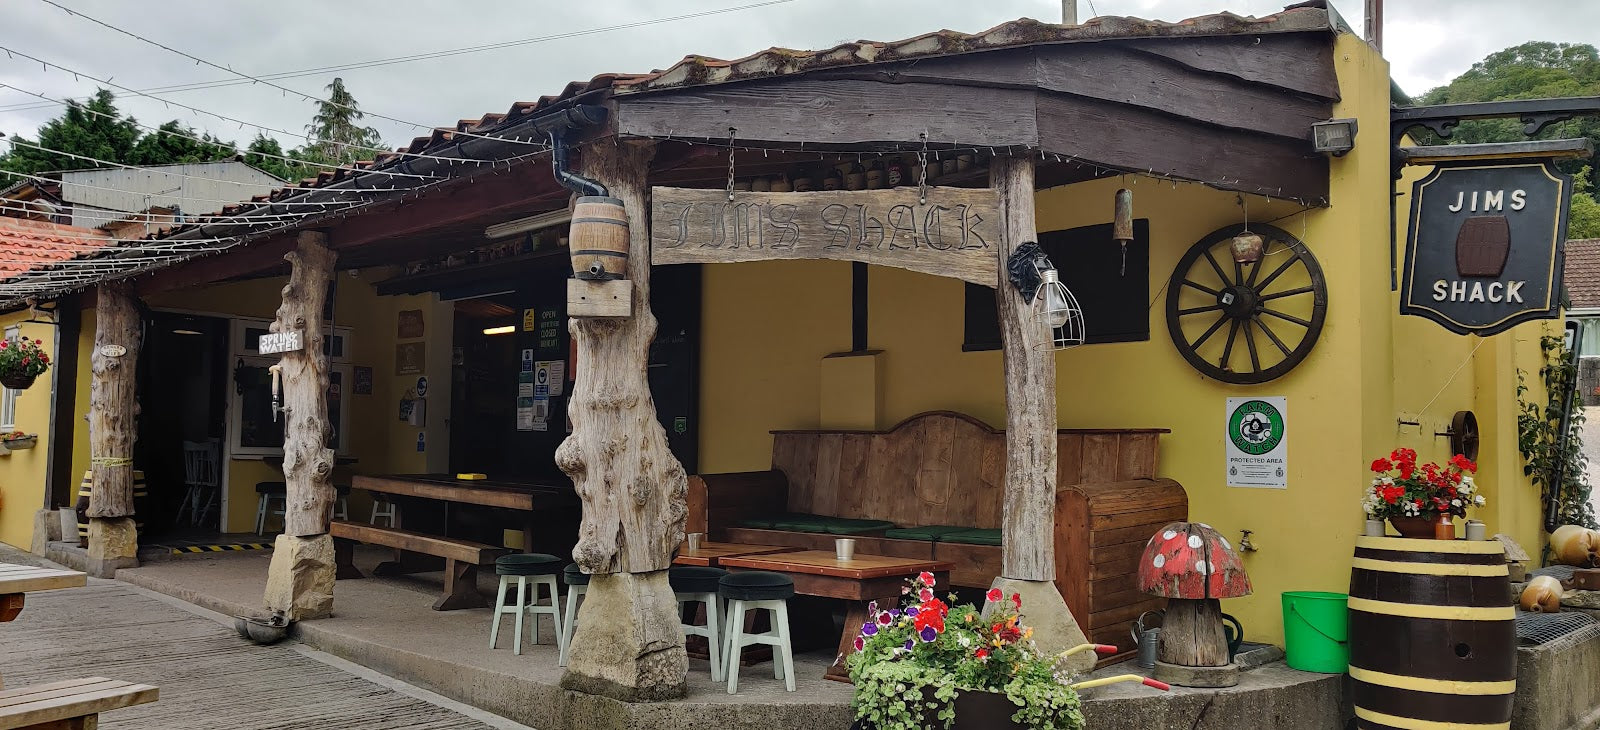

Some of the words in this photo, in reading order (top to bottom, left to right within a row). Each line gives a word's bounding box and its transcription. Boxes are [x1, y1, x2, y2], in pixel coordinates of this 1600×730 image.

[1448, 189, 1527, 212] JIMS
[1432, 279, 1526, 303] SHACK
[542, 310, 556, 319] OPEN
[261, 331, 298, 346] SPRING
[541, 328, 557, 338] CLOSED
[260, 339, 299, 353] WATER
[1239, 402, 1275, 417] FARM
[1234, 436, 1278, 453] WATCH
